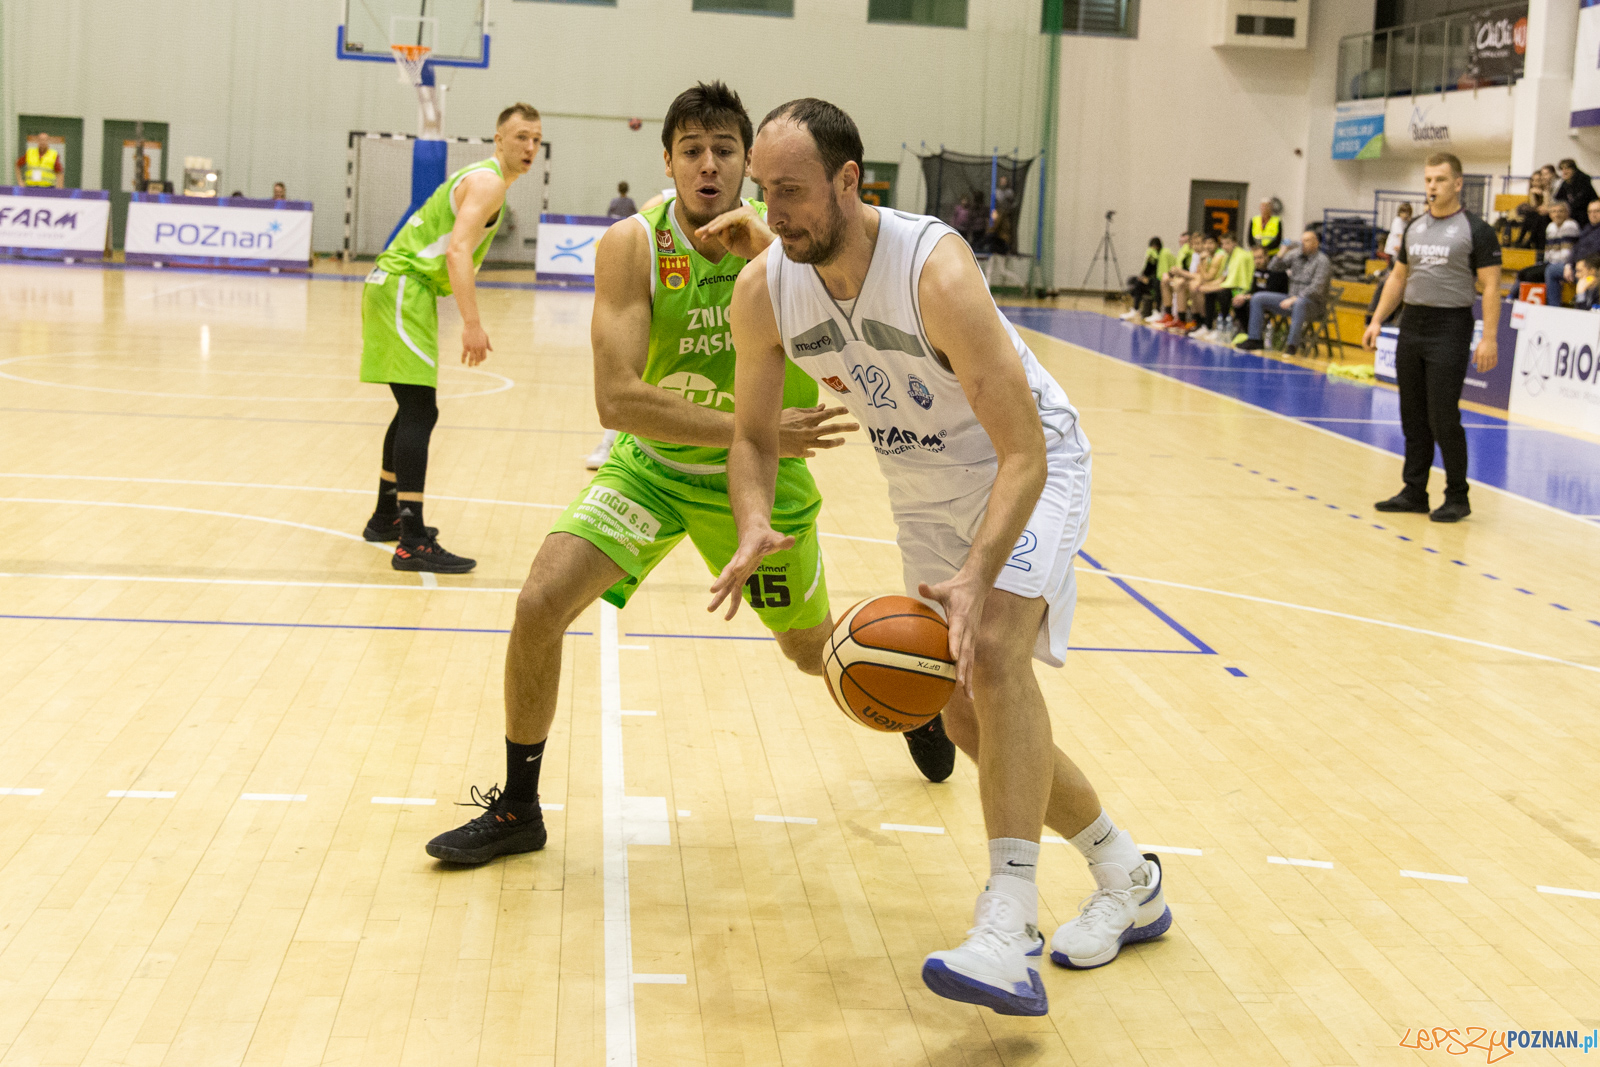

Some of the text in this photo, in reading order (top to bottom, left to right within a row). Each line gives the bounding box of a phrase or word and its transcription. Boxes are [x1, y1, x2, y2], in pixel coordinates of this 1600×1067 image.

[1526, 287, 1543, 305] 5
[851, 364, 897, 409] 12
[874, 444, 916, 455] RODUCENT
[590, 490, 630, 516] LOGO
[757, 564, 787, 572] elman
[745, 573, 791, 608] 15
